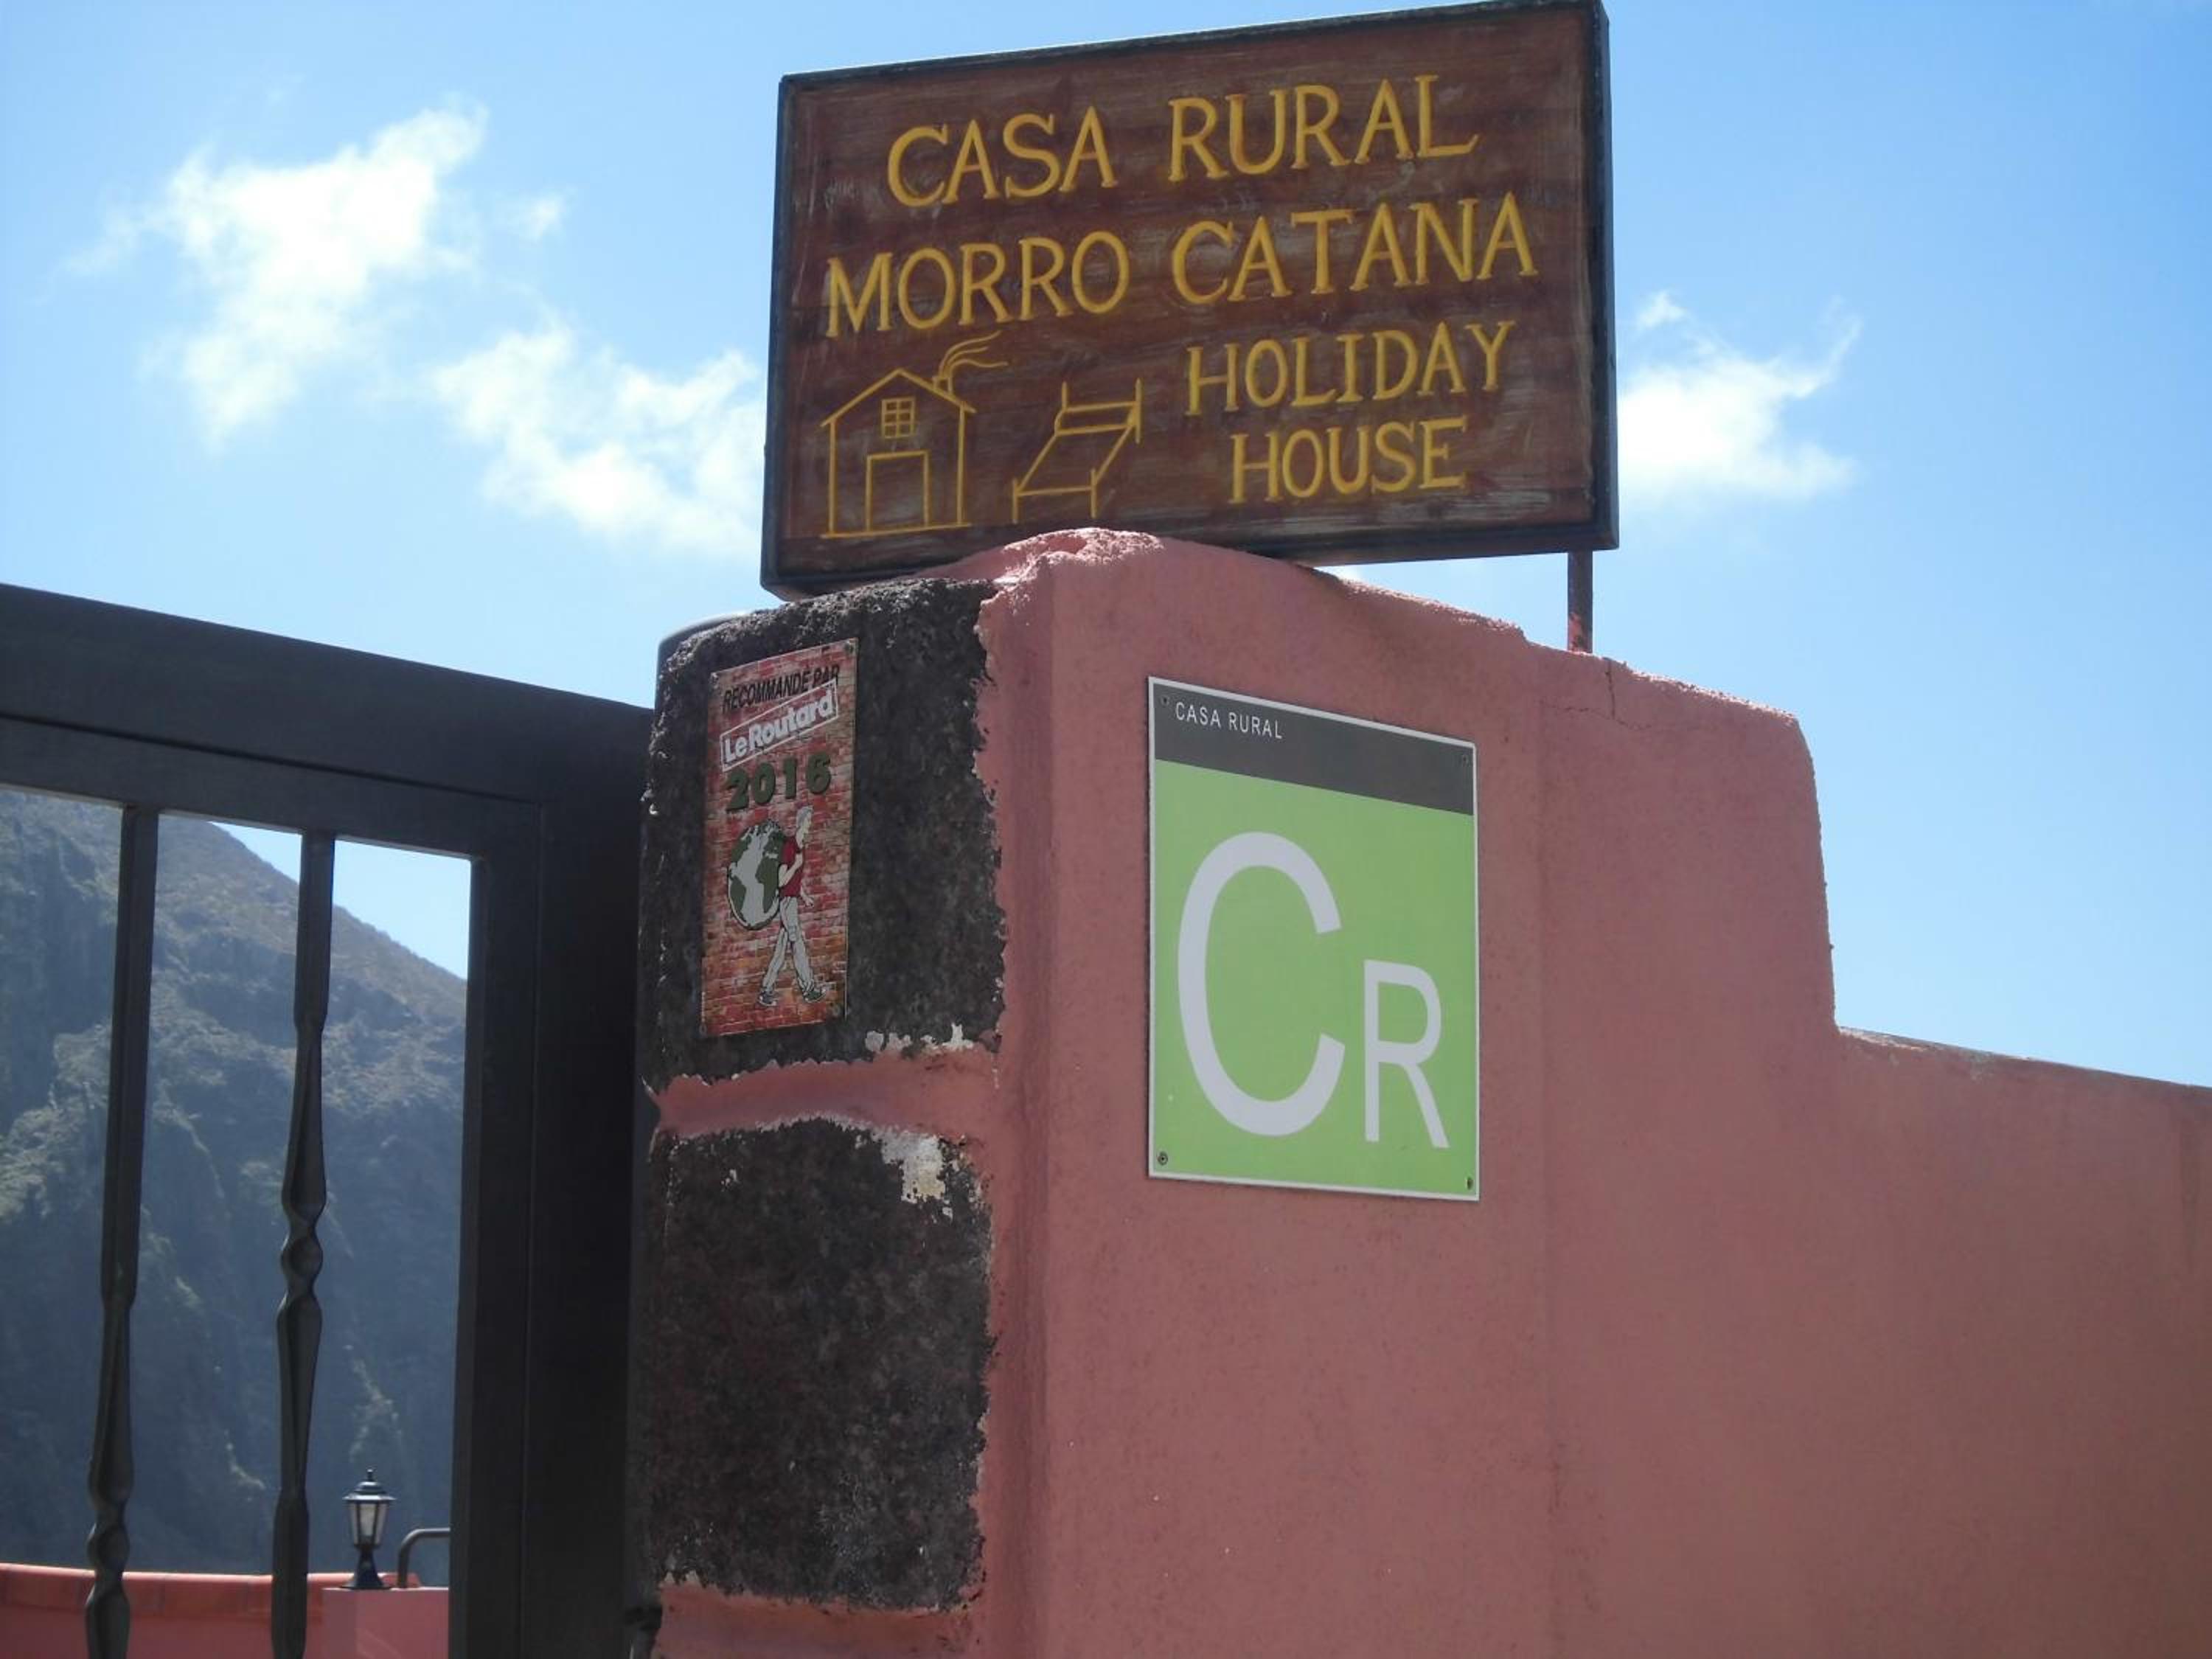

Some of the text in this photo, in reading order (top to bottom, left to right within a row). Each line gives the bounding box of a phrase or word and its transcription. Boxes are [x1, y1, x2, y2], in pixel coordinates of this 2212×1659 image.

[888, 74, 1479, 208] CASA RURAL
[824, 191, 1538, 338] MORRO CATANA
[1186, 321, 1515, 416] HOLIDAY
[1229, 416, 1468, 504] HOUSE
[1175, 700, 1284, 740] CASA RURAL
[726, 752, 831, 813] 2016
